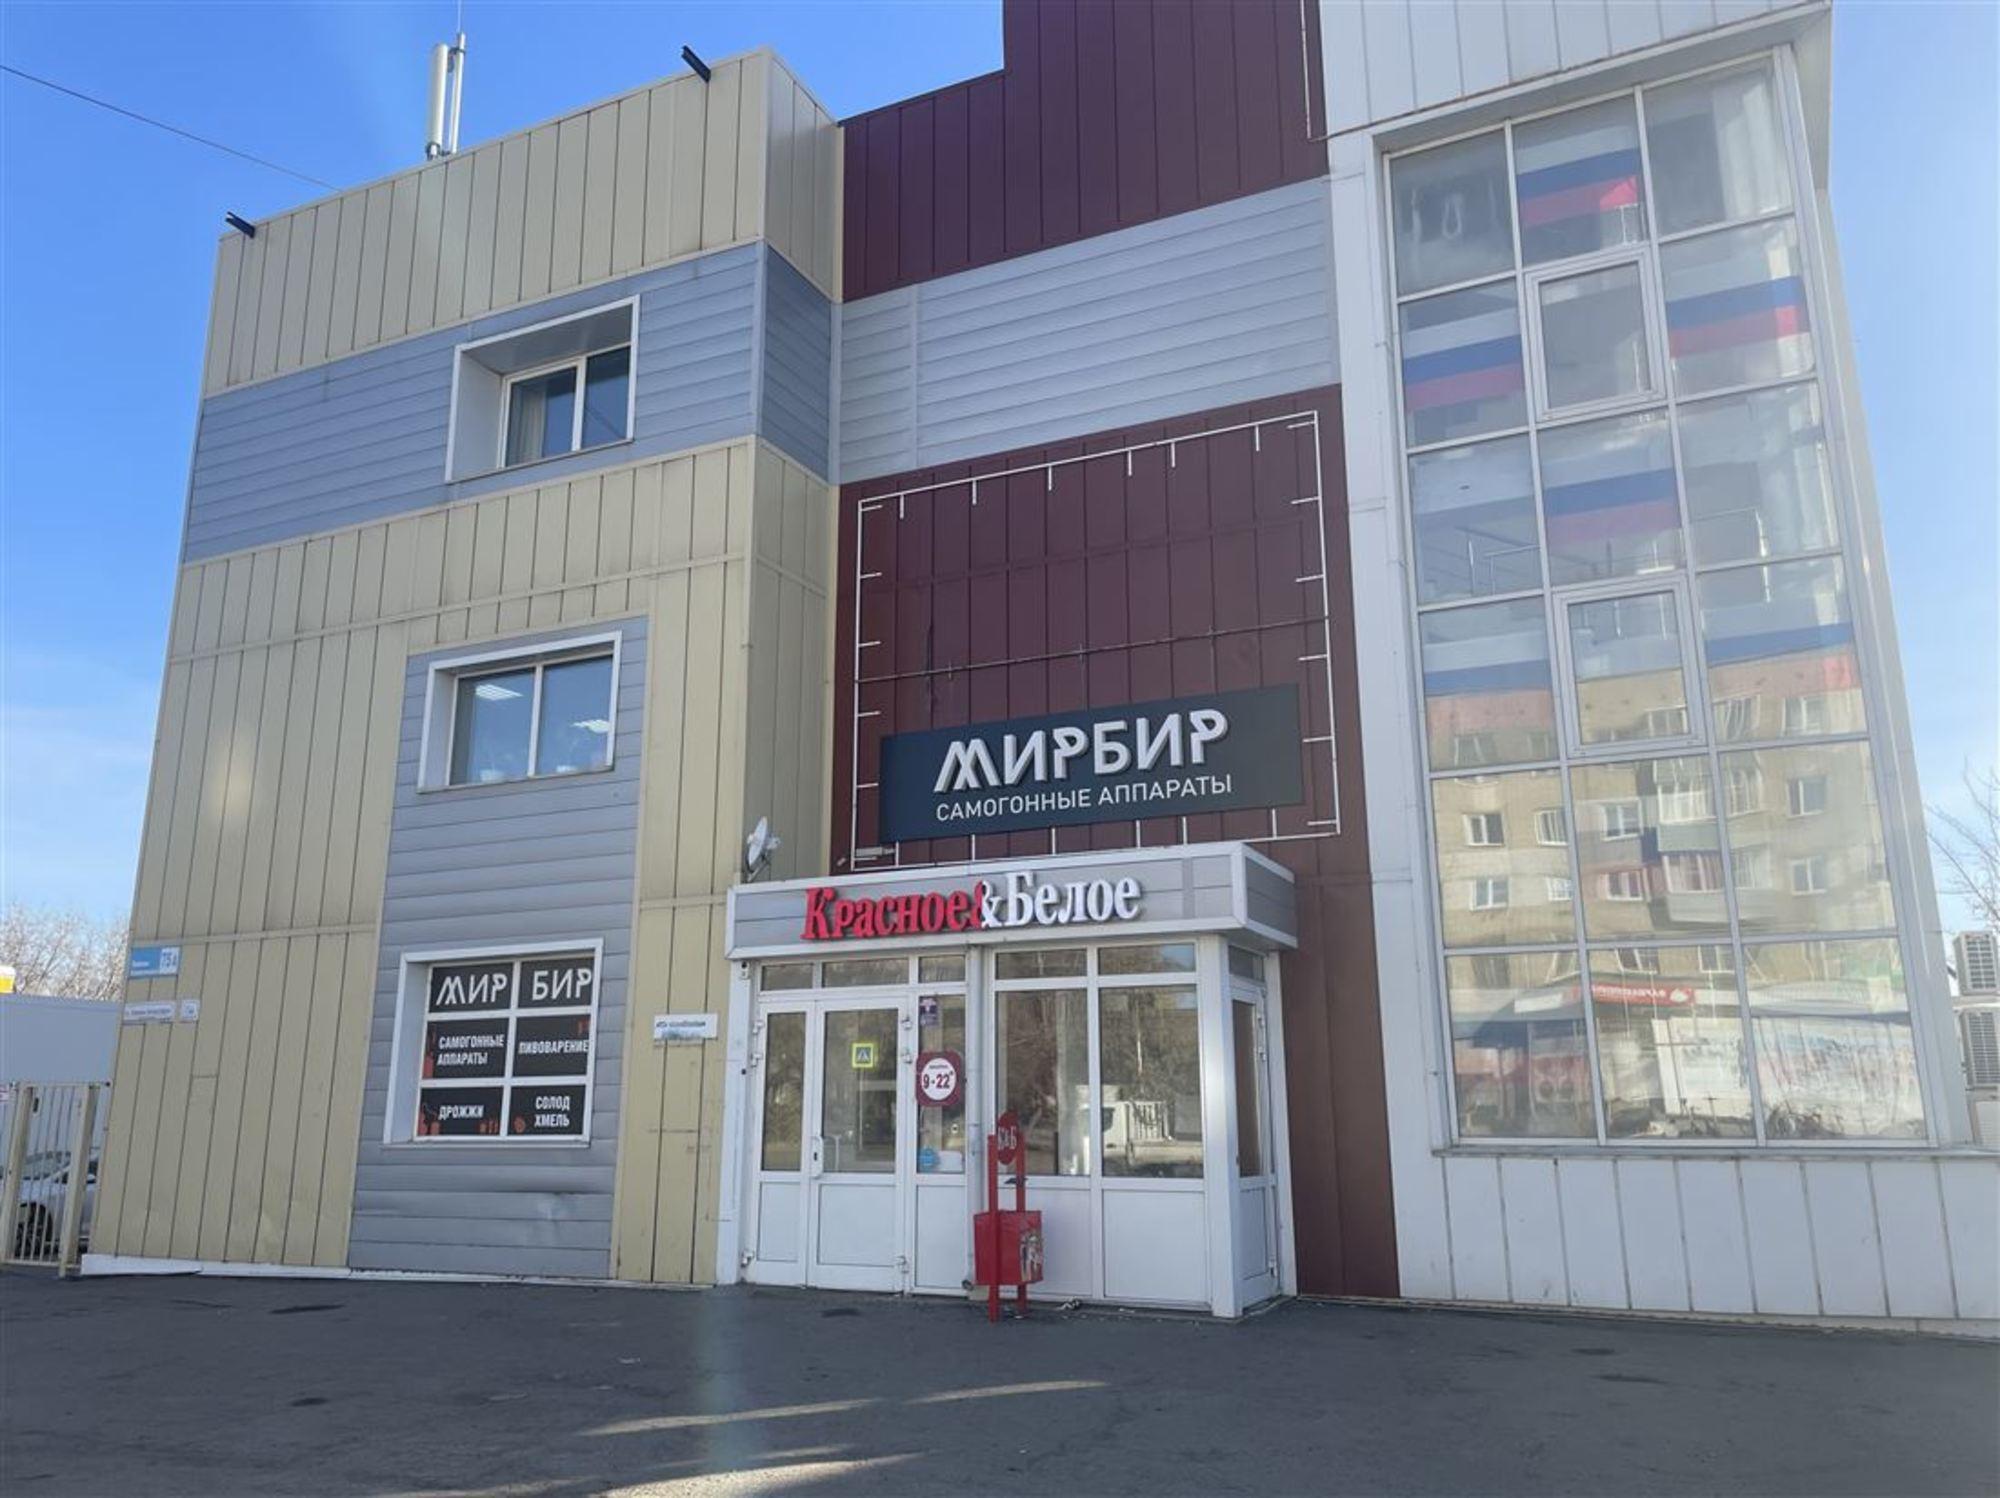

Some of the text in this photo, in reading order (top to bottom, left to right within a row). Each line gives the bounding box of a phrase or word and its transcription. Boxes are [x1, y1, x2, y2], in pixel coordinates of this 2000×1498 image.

[934, 708, 1229, 794] МИРБИР
[936, 773, 1232, 822] САМОГОННЫЕ АППАРАТЫ
[435, 967, 592, 1006] МИР БИР
[438, 1033, 505, 1050] САМОГОННЫЕ
[518, 1039, 590, 1055] ПИВОВАРЕНИЕ
[437, 1052, 488, 1066] АППАРАТЫ
[535, 1096, 571, 1111] СОЛОД
[438, 1105, 484, 1121] ДРОЖЖИ
[534, 1113, 570, 1127] ХМЕЛЬ
